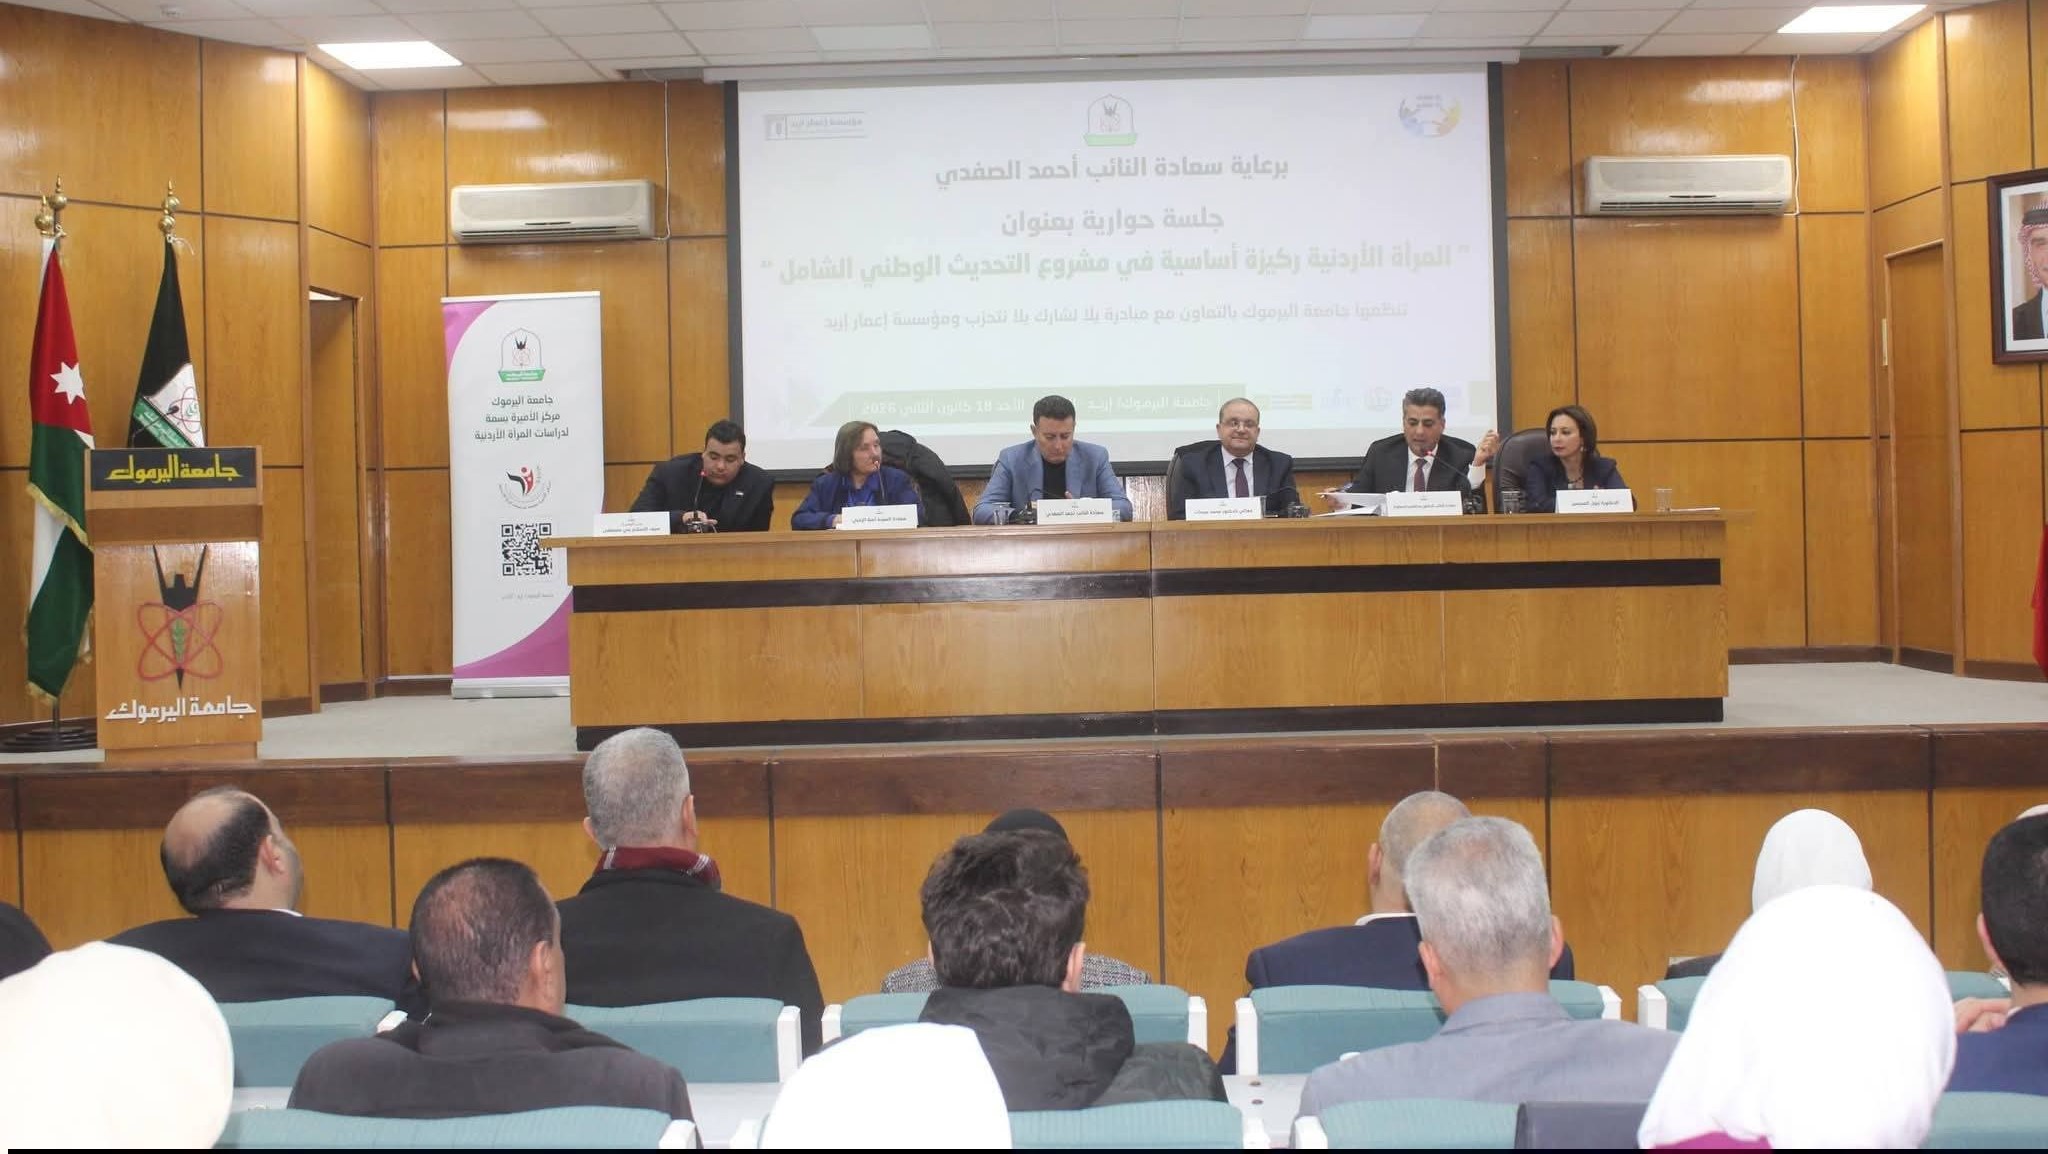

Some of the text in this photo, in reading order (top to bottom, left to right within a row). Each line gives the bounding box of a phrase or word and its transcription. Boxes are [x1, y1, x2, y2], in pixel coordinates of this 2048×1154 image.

[935, 153, 1289, 190] برعاية سعادة النائب أحمد الصفدي
[1001, 205, 1224, 237] جلسة حوارية بعنوان
[779, 255, 852, 286] الشامل
[859, 254, 941, 288] الوطني
[947, 252, 1031, 282] التحديث
[1037, 249, 1111, 280] مشروع
[1116, 250, 1153, 282] في
[1160, 242, 1239, 277] أساسية
[1244, 246, 1300, 275] ركيزة
[1308, 241, 1383, 275] الأردنية
[1391, 241, 1451, 272] المرأة
[893, 308, 961, 331] ومؤسسة
[1104, 304, 1149, 325] مبادرة
[1153, 308, 1175, 325] مع
[1178, 302, 1237, 322] بالتعاون
[1241, 301, 1298, 323] اليرموك
[1303, 302, 1351, 319] جامعة
[491, 394, 554, 408] جامعة اليرموك
[485, 410, 560, 424] مركز الأميرة بسمة
[474, 427, 569, 442] لدراسات المرأة الأردنية
[104, 453, 244, 484] جامعة اليرموك
[104, 695, 256, 724] جامعة اليرموك
